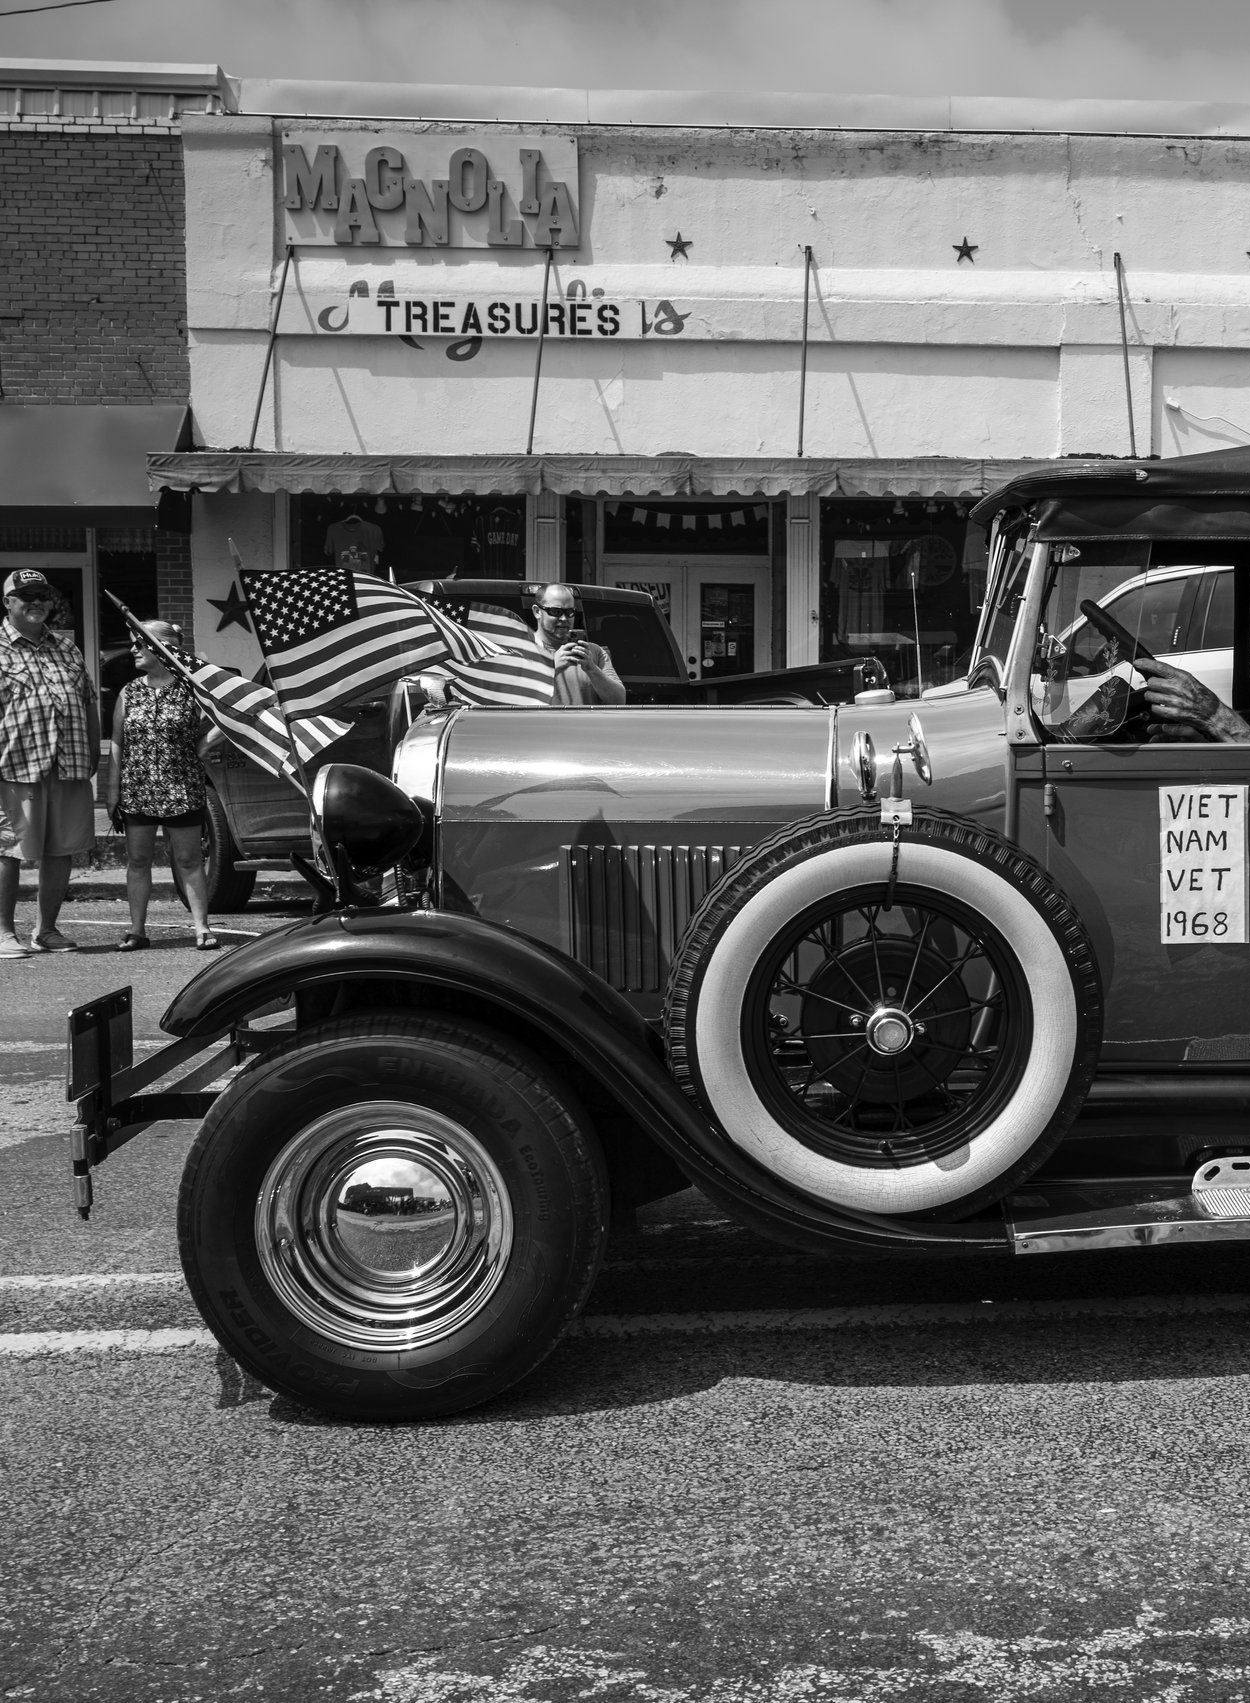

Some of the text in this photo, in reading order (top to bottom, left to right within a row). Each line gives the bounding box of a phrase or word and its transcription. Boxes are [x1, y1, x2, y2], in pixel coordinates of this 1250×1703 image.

[283, 144, 580, 247] MAGNOLIA
[377, 300, 620, 336] TREASURES
[1167, 794, 1238, 820] VIET
[1167, 829, 1227, 854] NAM
[1166, 868, 1231, 891] VET
[1166, 910, 1228, 937] 1968
[219, 1286, 361, 1397] PROVIDER
